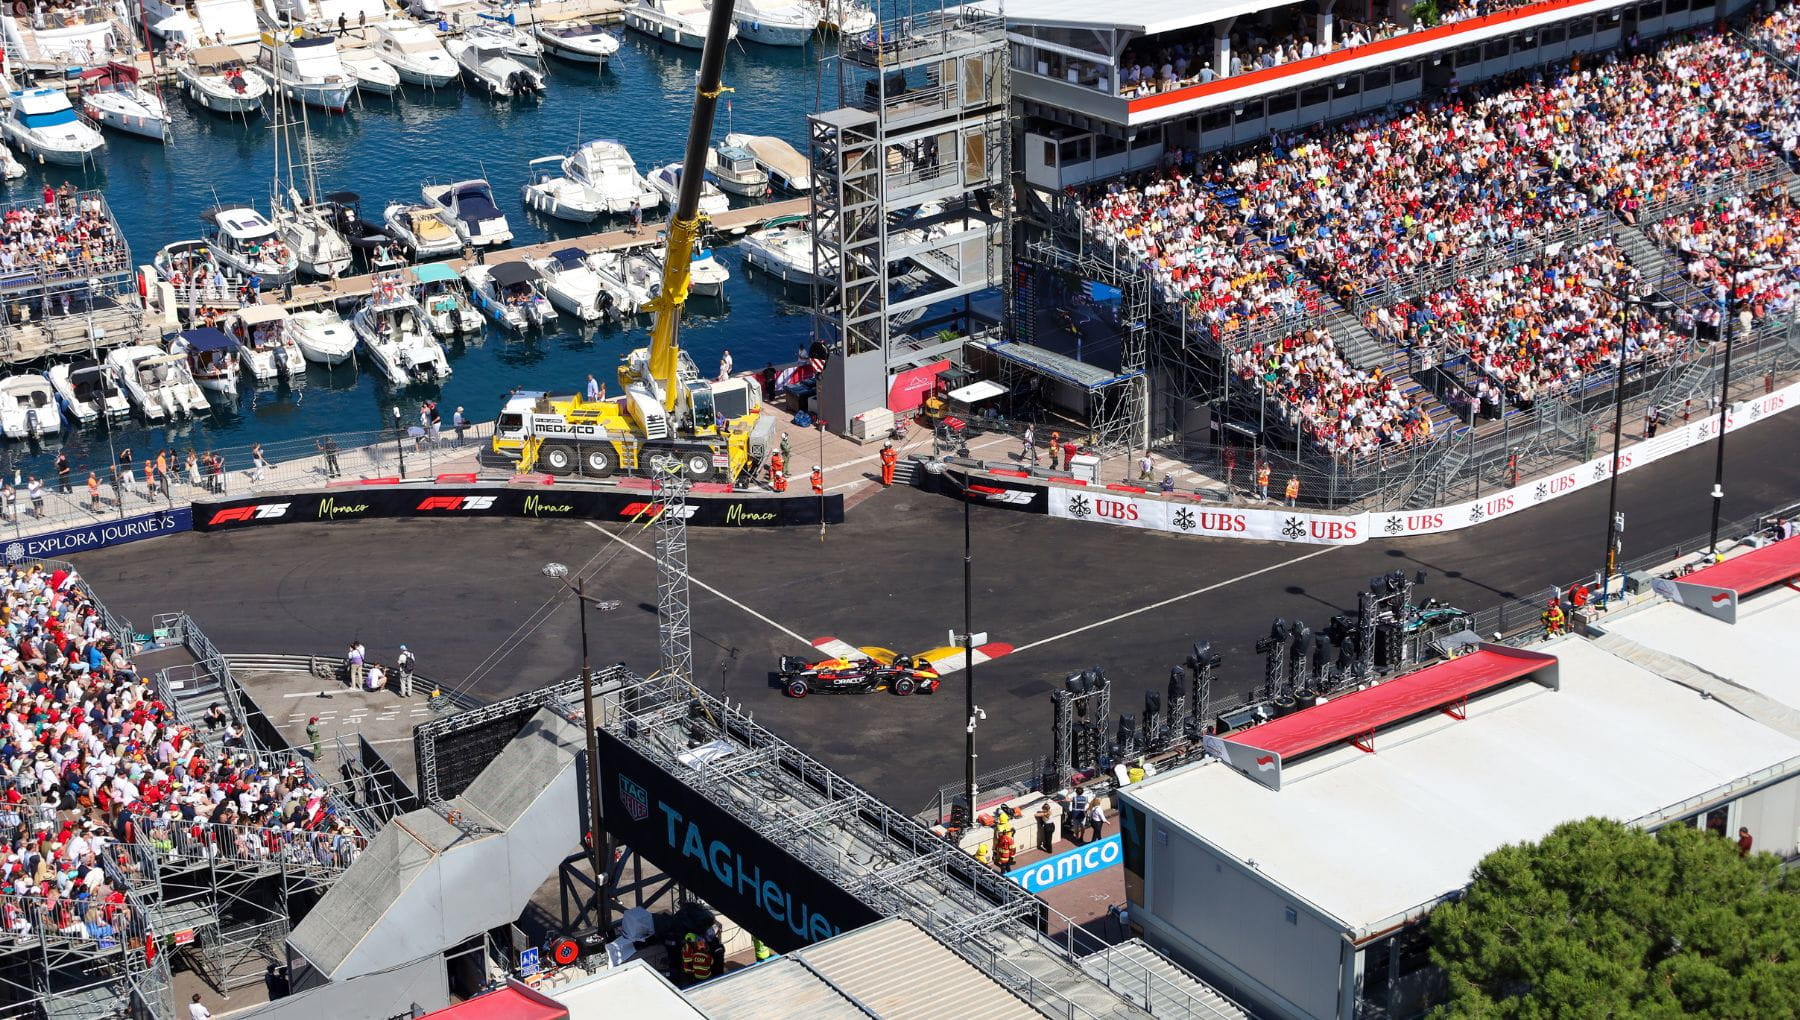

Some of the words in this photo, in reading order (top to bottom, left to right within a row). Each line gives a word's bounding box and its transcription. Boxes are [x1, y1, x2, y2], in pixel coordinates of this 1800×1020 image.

[1763, 394, 1784, 413] UBS
[1550, 473, 1576, 494] UBS
[318, 496, 370, 520] Monaco
[523, 494, 573, 518] Monaco
[725, 503, 776, 527] Monaco
[1095, 498, 1139, 521] UBS
[1486, 494, 1515, 516] UBS
[1200, 512, 1247, 532] UBS
[1310, 520, 1357, 540] UBS
[1407, 513, 1443, 531] UBS
[28, 531, 99, 555] EXPLORA
[100, 515, 176, 545] JOURNEYS
[621, 777, 646, 803] TAG
[1010, 841, 1119, 888] ramco
